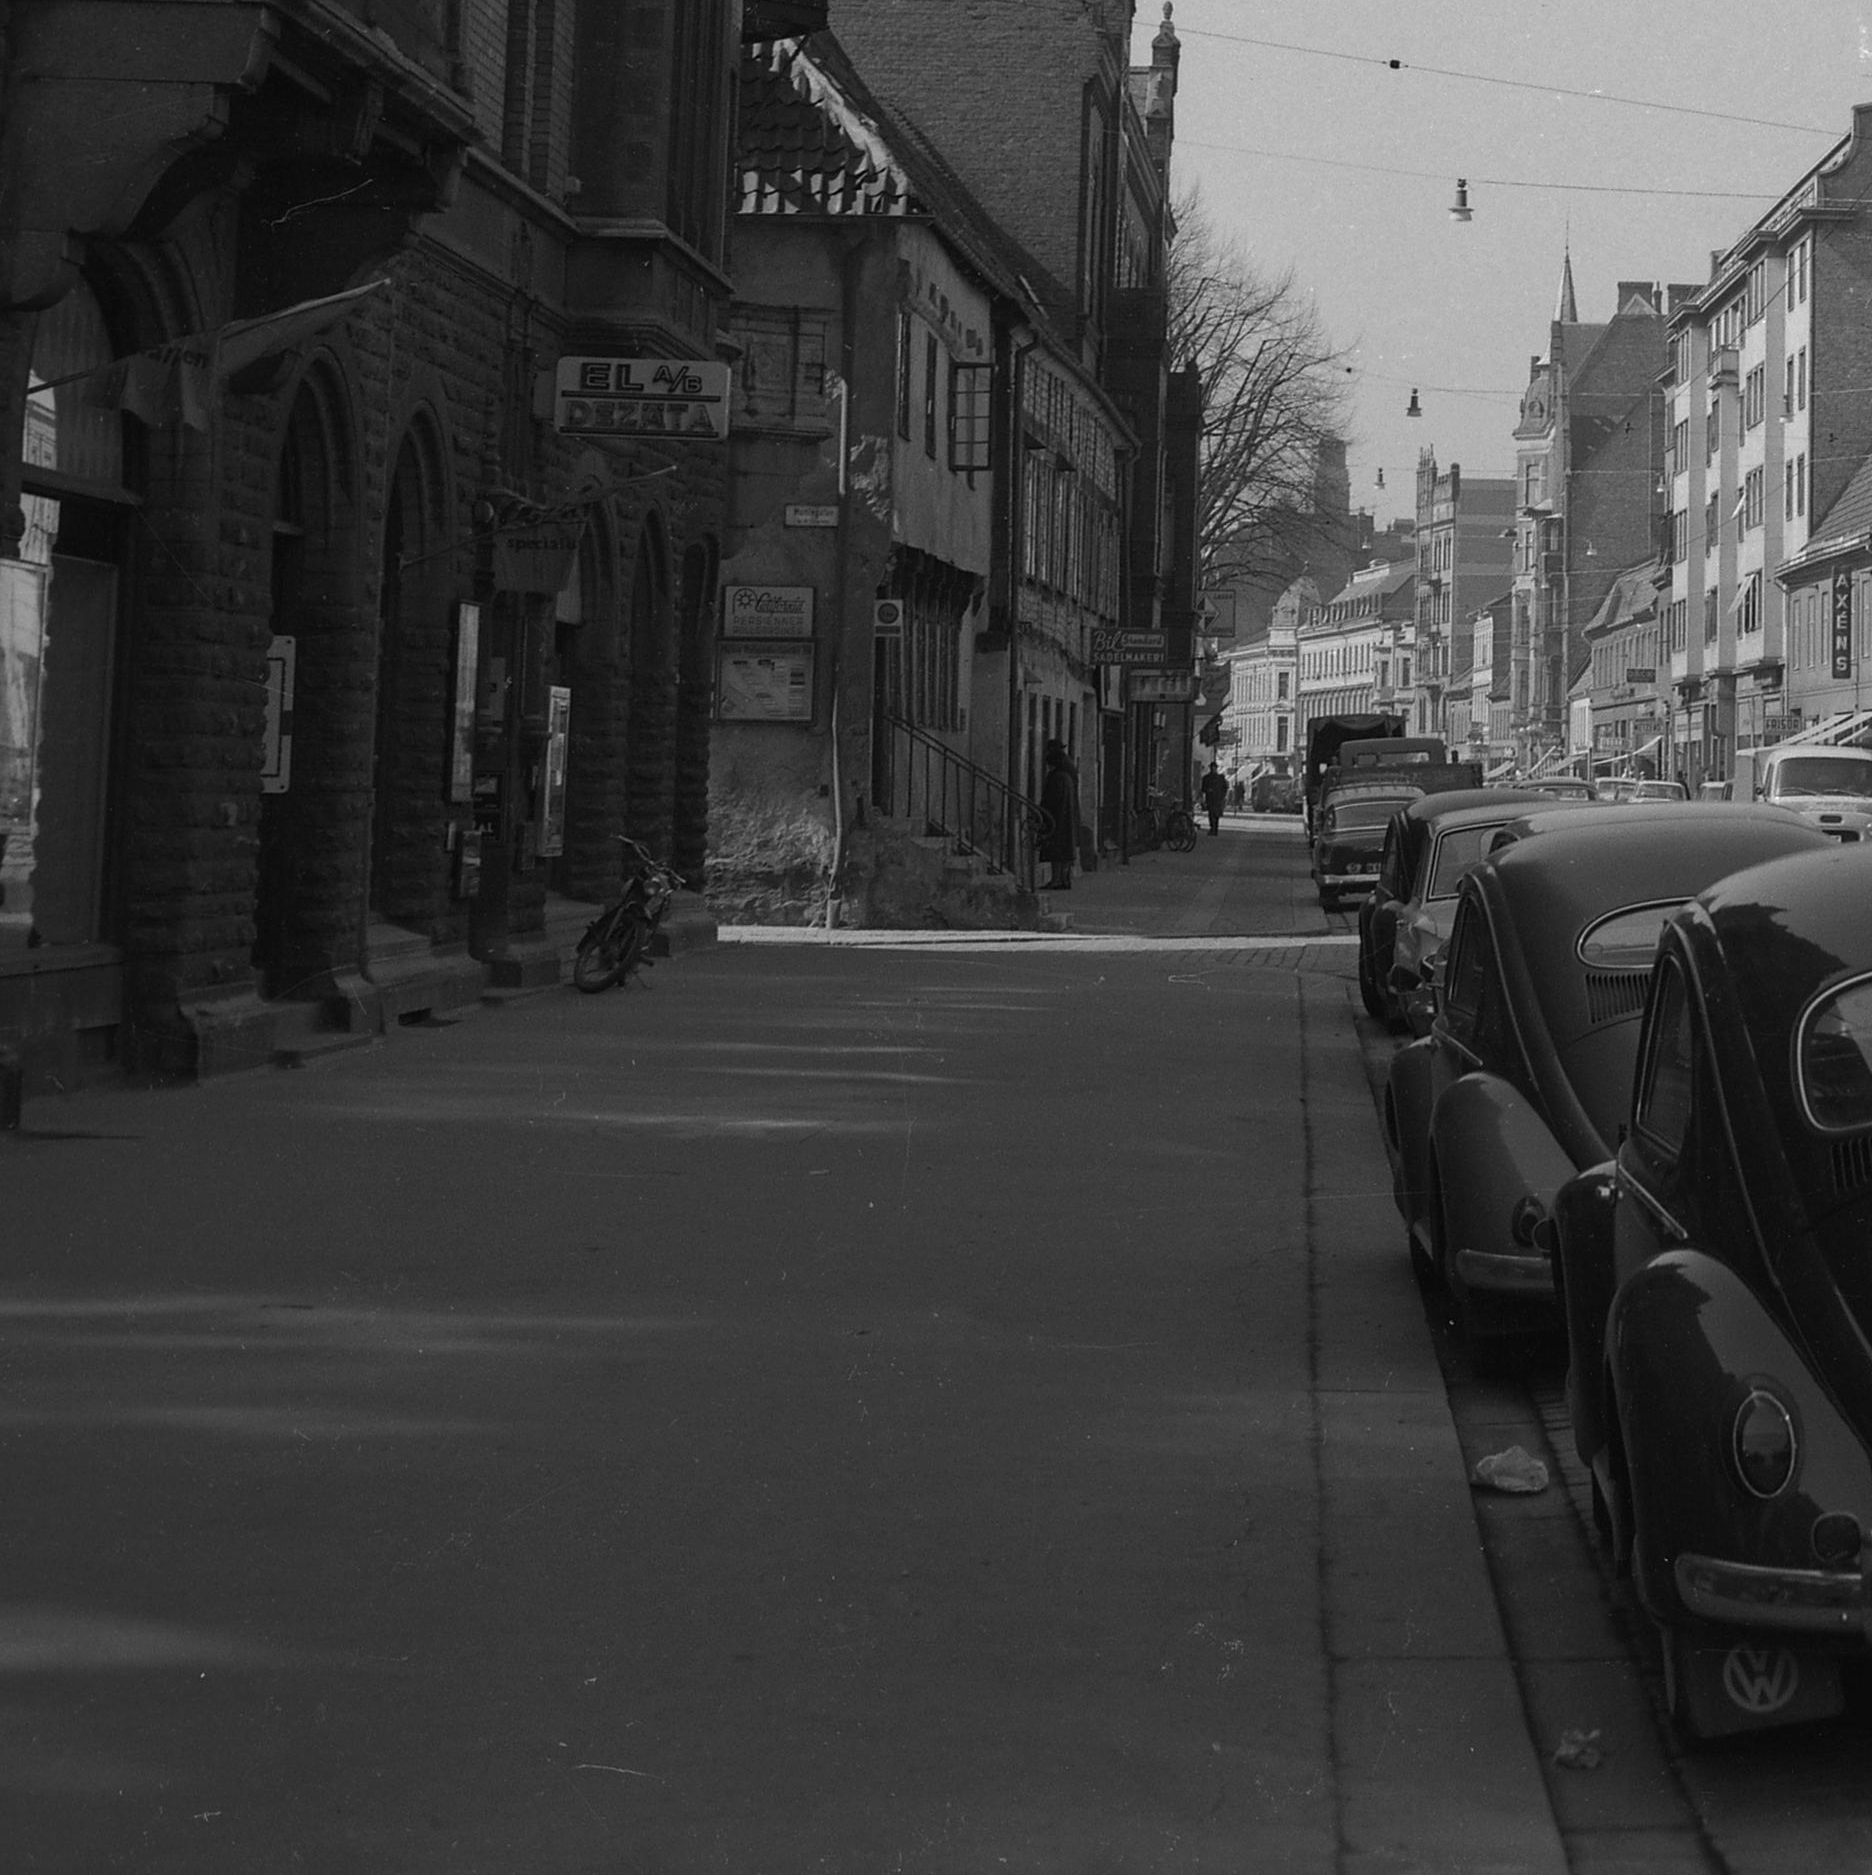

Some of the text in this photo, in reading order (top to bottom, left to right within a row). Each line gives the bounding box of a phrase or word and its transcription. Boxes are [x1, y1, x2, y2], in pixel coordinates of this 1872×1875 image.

[581, 362, 703, 393] EL A/B
[1836, 574, 1849, 672] AXÉNS
[1093, 630, 1125, 652] Bil
